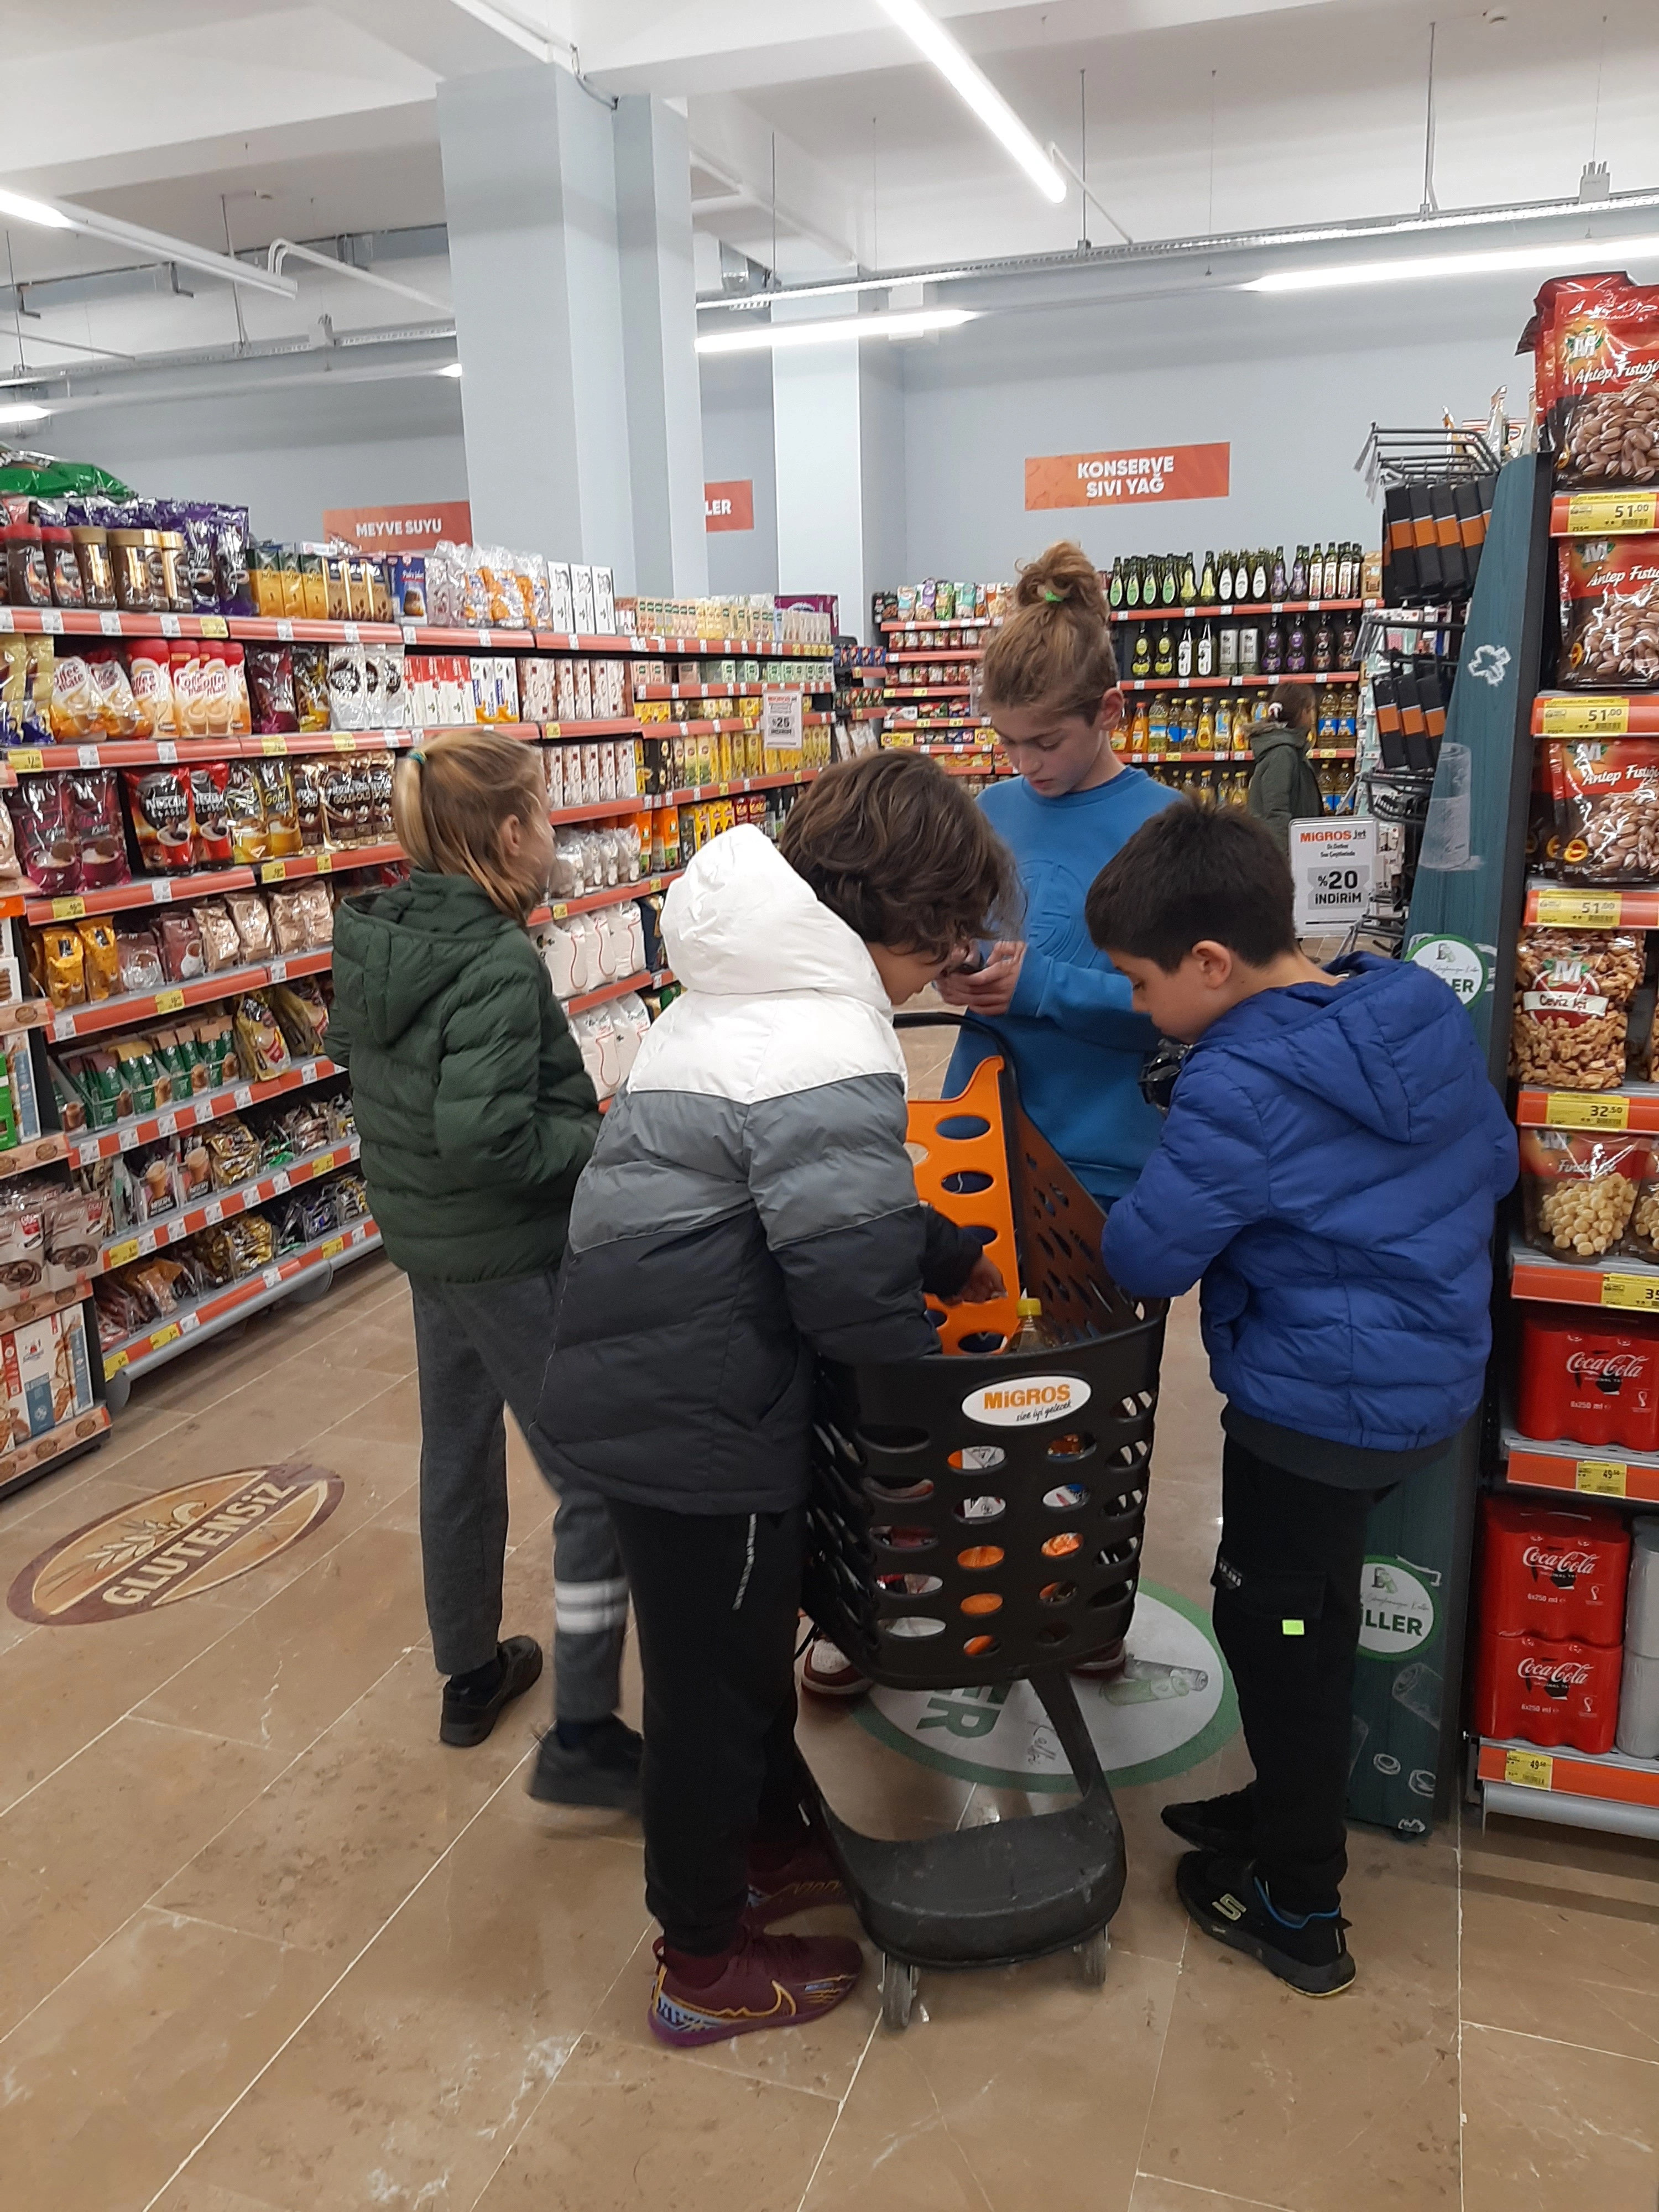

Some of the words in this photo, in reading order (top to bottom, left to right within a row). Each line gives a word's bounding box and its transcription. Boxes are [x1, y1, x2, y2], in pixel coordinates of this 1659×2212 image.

[1574, 368, 1613, 385] Antep
[1078, 456, 1174, 479] KONSERVE
[1086, 479, 1121, 498] SIVI
[1126, 473, 1164, 495] YAĞ
[705, 499, 732, 515] LER
[356, 520, 402, 538] MEYVE
[405, 518, 442, 535] SUYU
[1587, 569, 1625, 587] Antep
[1582, 770, 1622, 786] Antep
[1318, 870, 1358, 890] %20
[1540, 994, 1568, 1006] Ceviz
[1566, 1352, 1649, 1378] Coca-Cola
[1522, 1546, 1601, 1574] Coca-Cola
[1364, 1609, 1422, 1637] LLER
[1517, 1657, 1594, 1684] Coca-Cola
